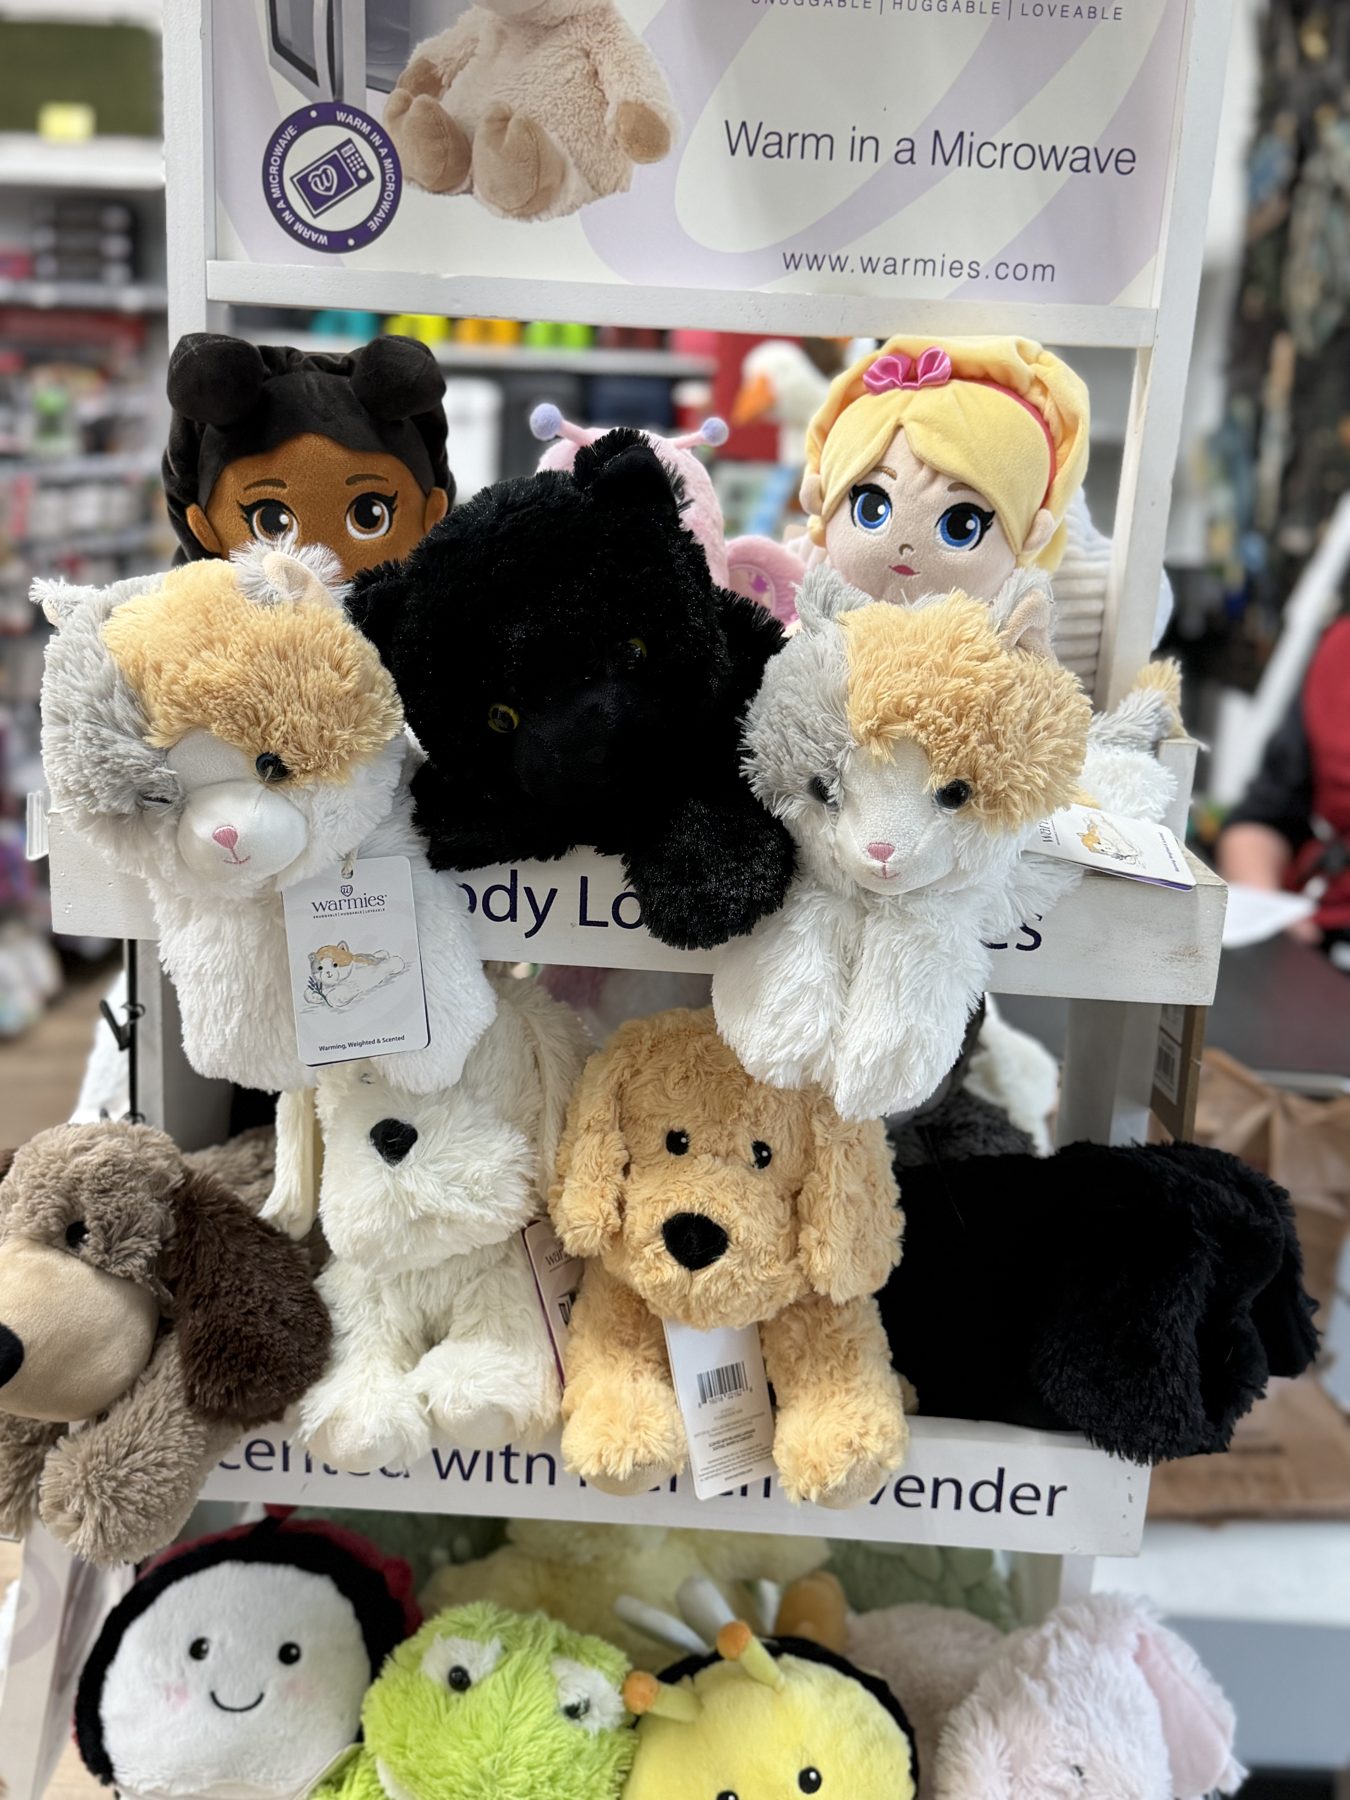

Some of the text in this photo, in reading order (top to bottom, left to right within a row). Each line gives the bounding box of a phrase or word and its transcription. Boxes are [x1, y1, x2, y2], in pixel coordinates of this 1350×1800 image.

[892, 0, 1001, 15] HUGGABLE
[1021, 3, 1123, 20] LOVEABLE
[724, 119, 1137, 176] Warm in a Microwave
[269, 124, 329, 246] WARM IN A MICROWAVE
[335, 111, 395, 232] WARM IN A MICROWAVE
[782, 252, 1056, 282] www.warmies.com
[311, 893, 387, 912] warmies
[579, 875, 649, 929] Lo
[347, 1039, 376, 1047] Weighted
[382, 1035, 405, 1043] Scented
